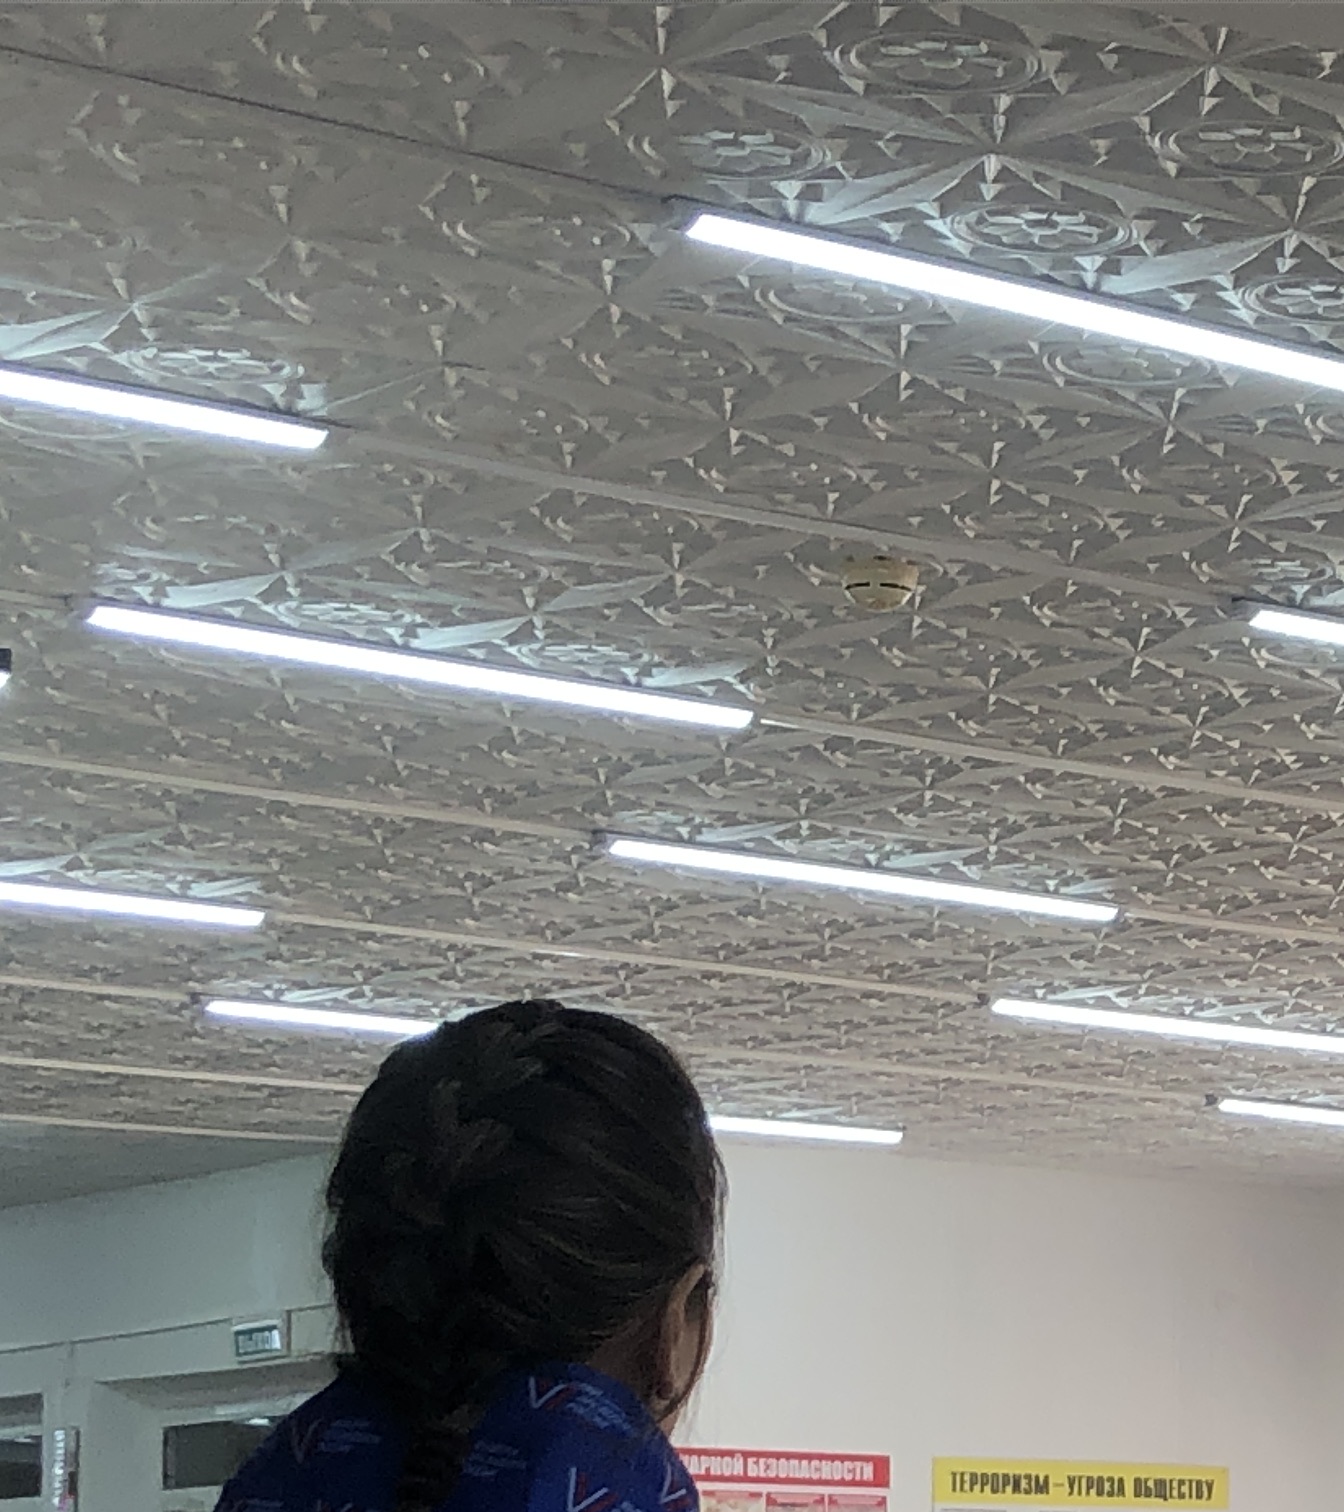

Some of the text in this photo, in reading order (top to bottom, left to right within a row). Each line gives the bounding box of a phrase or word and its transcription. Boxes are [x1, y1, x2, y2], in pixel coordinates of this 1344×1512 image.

[747, 1457, 874, 1482] БЕЗОПАСНОСТИ
[950, 1471, 1050, 1495] ТЕРРОРИЗМ
[1067, 1475, 1126, 1498] УГРОЗА
[1133, 1477, 1215, 1501] ОБЩЕСТВУ
